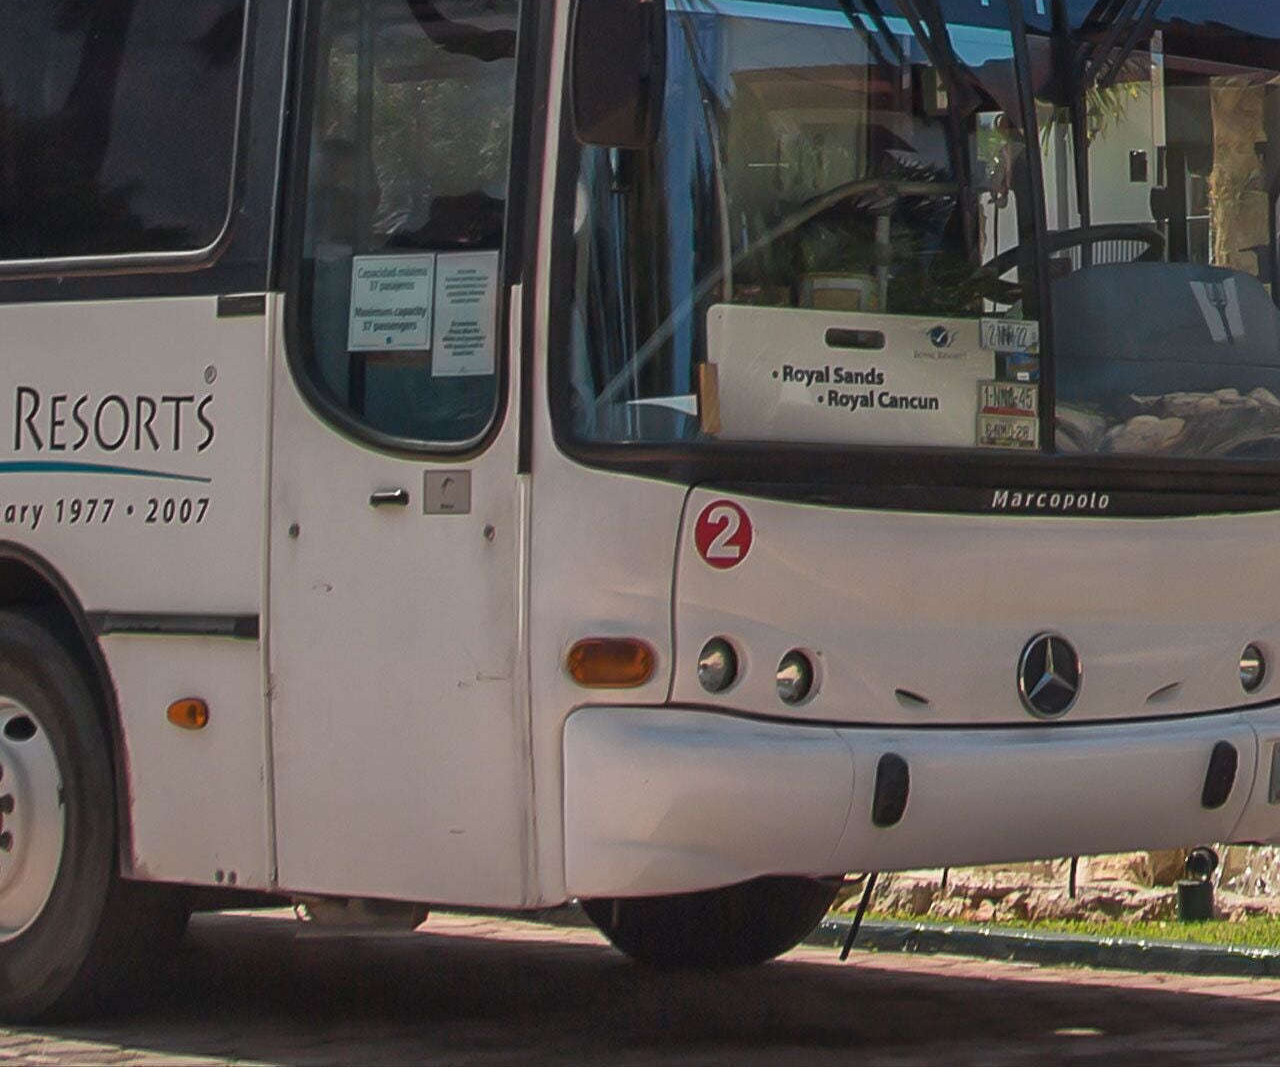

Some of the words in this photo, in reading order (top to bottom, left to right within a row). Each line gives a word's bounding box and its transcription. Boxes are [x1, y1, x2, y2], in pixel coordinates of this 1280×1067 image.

[781, 365, 830, 387] Royal
[833, 367, 884, 386] Sands
[827, 389, 874, 412] Royal
[877, 391, 939, 411] Cancun
[13, 385, 215, 453] RESORTS
[55, 497, 115, 525] 1977
[144, 497, 211, 525] 2007
[991, 489, 1110, 510] Marcopolo
[706, 506, 740, 558] 2
